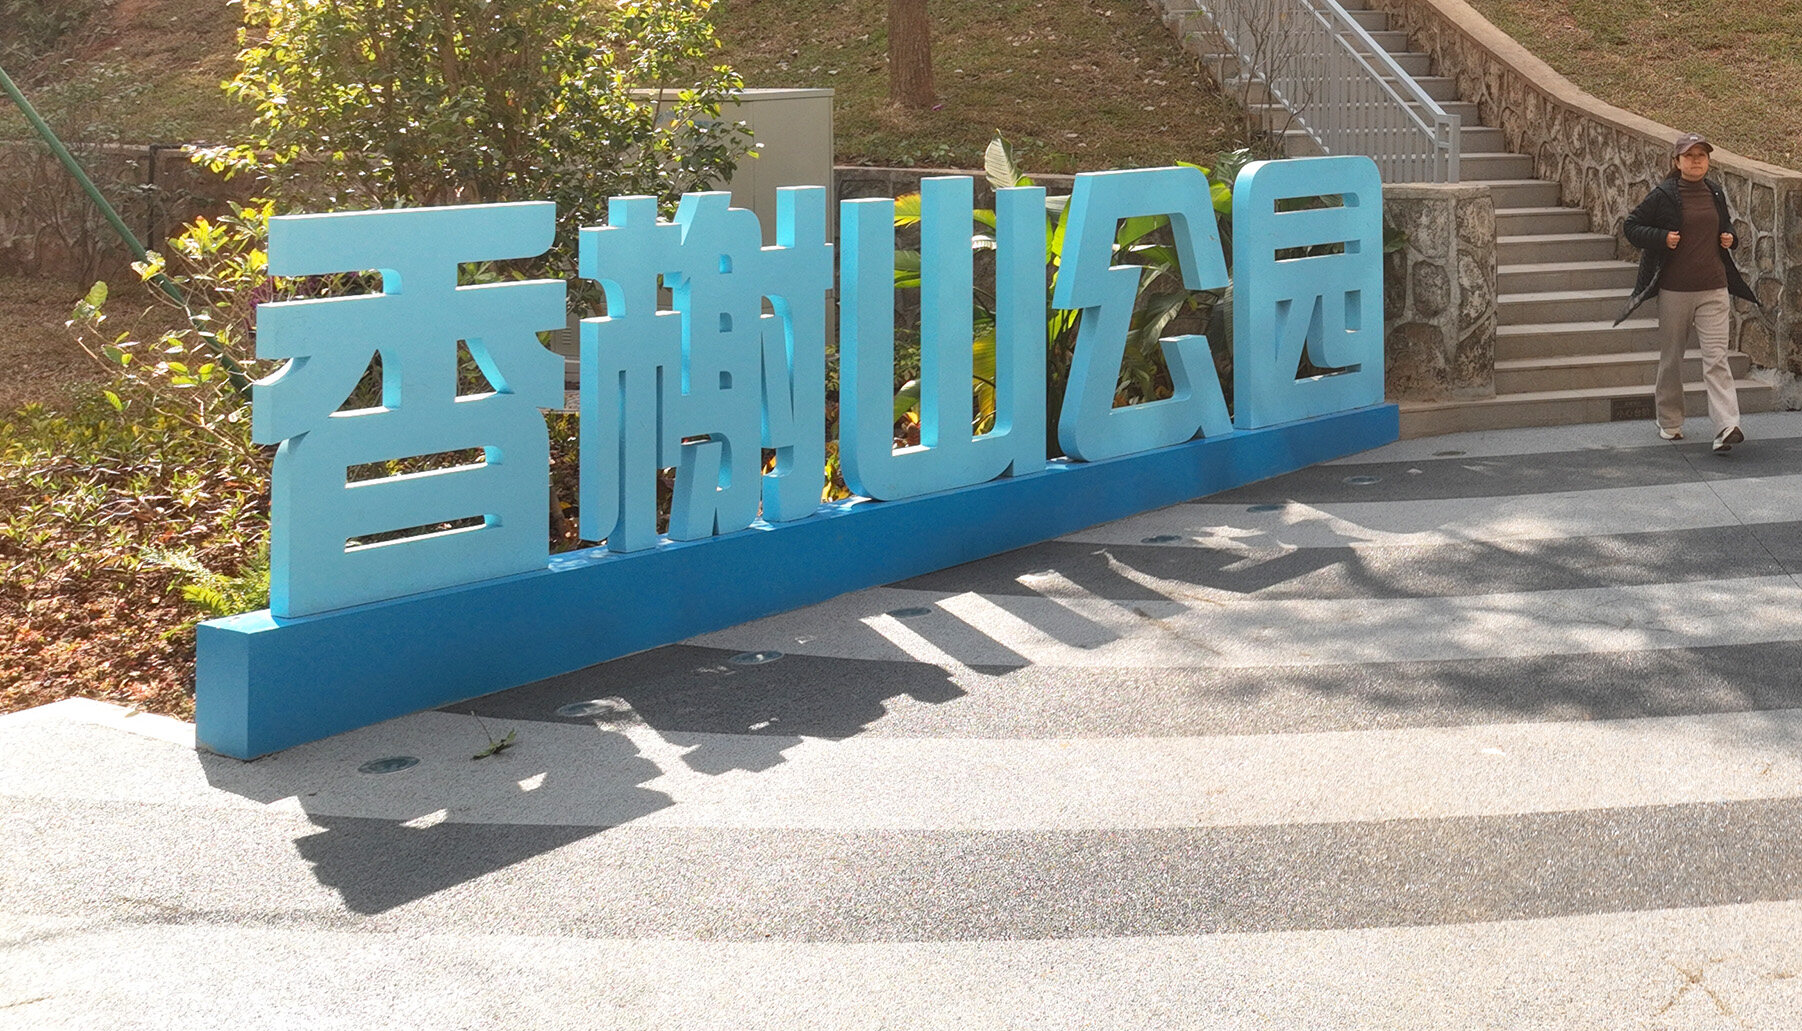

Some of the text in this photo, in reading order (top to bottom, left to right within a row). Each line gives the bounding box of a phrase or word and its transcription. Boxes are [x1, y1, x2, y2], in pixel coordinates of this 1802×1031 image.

[254, 155, 1385, 619] 香榭山公园
